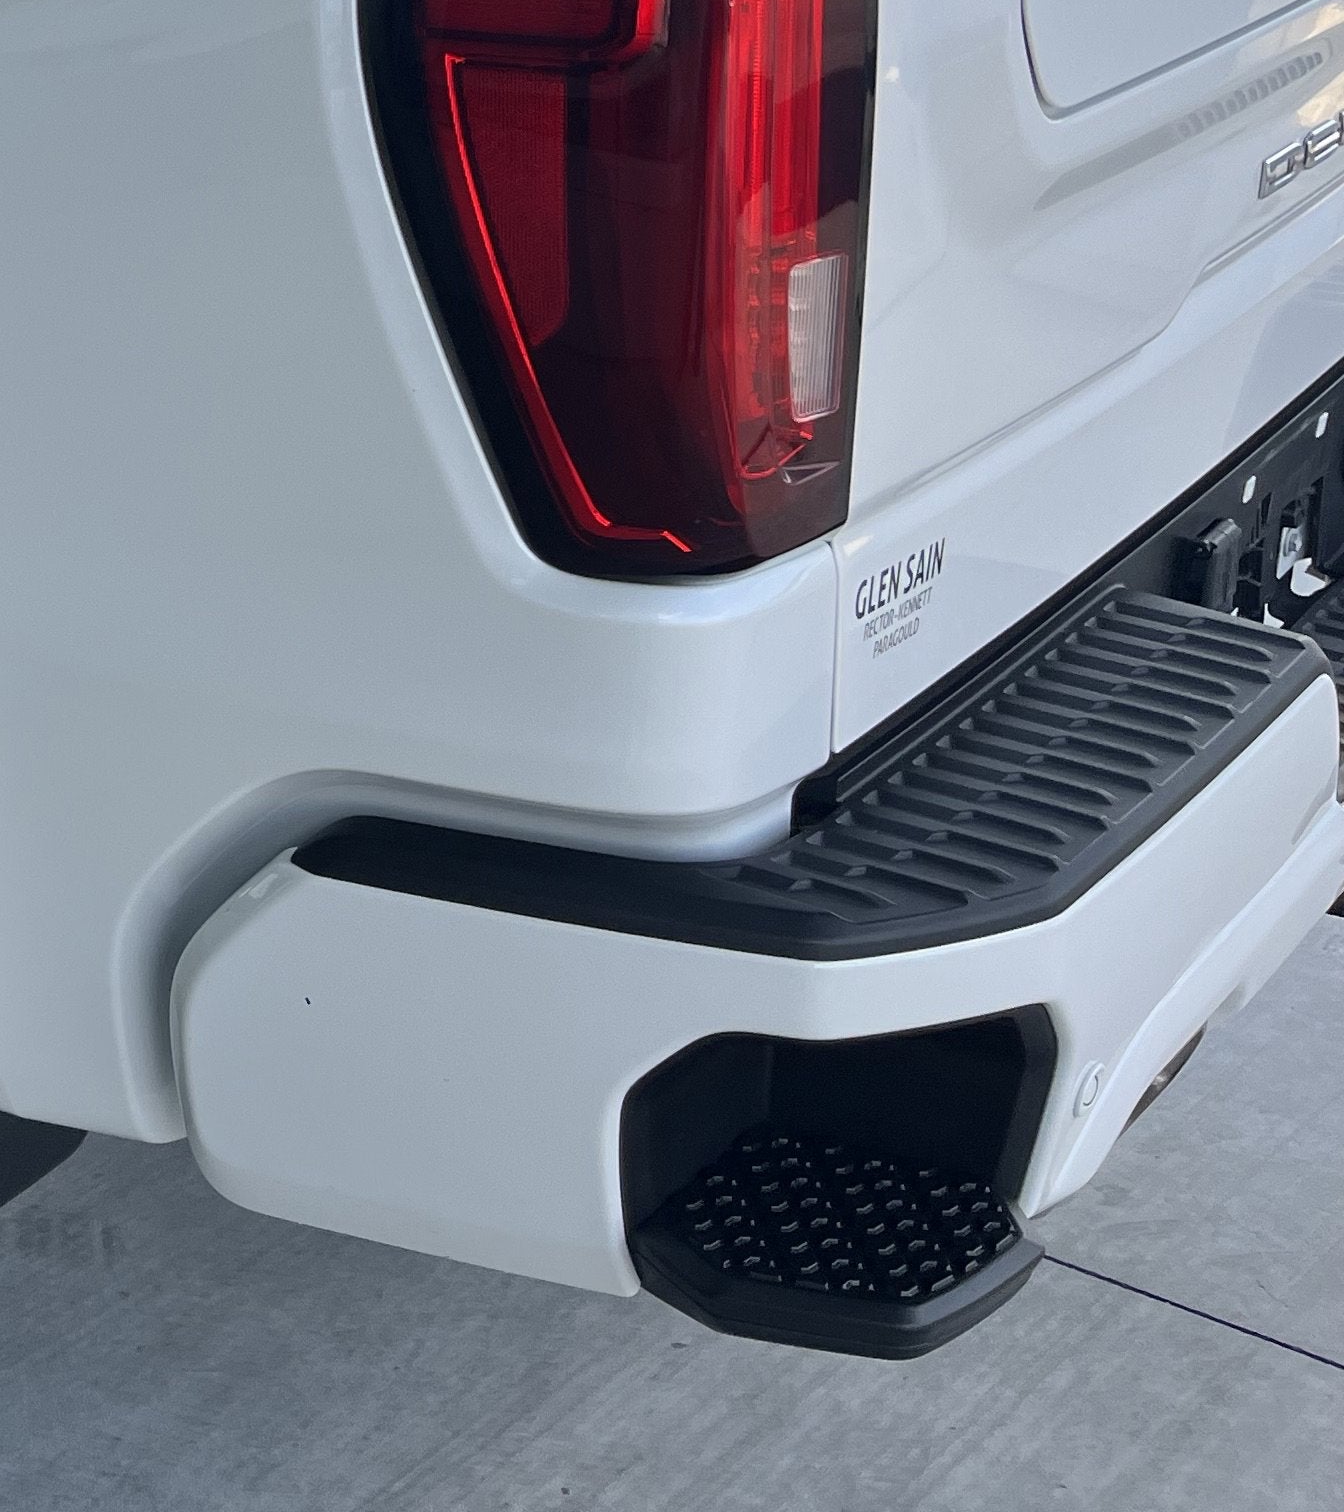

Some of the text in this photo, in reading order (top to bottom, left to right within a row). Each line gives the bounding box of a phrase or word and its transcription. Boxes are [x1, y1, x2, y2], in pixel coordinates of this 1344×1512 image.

[1258, 110, 1344, 200] DE
[855, 537, 946, 620] GLEN SAIN
[863, 586, 933, 641] RECTOR-KENNETT
[872, 617, 921, 659] PARAGOULD
